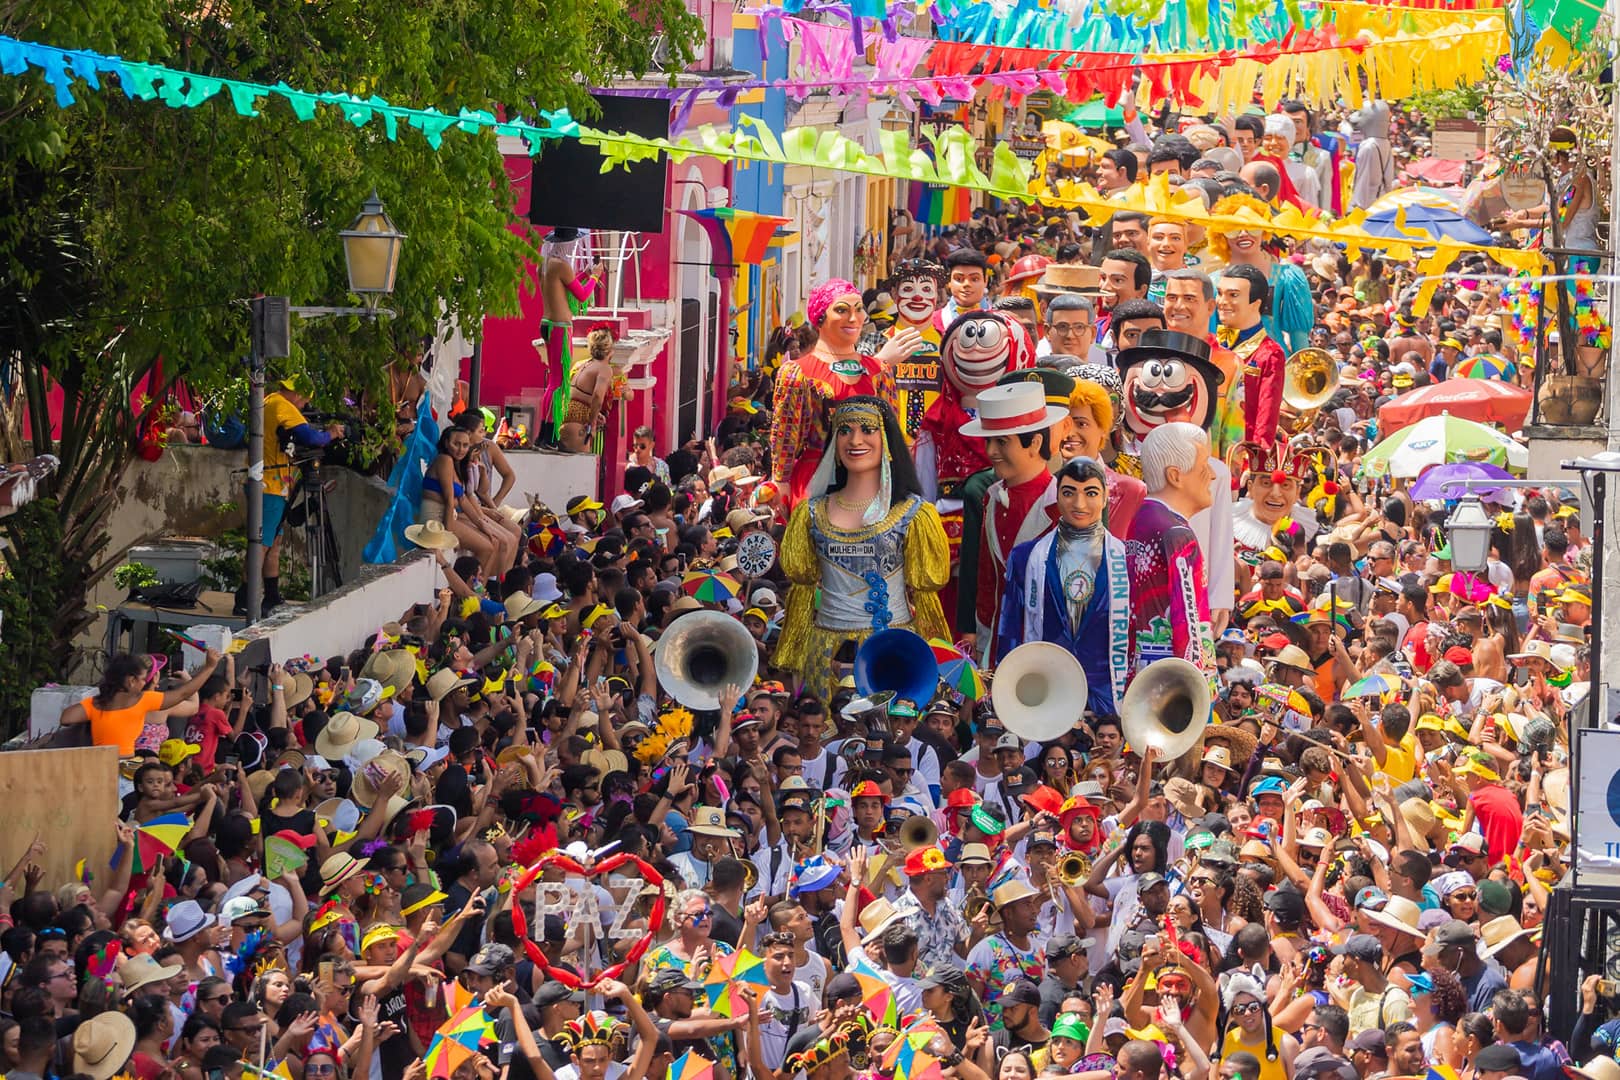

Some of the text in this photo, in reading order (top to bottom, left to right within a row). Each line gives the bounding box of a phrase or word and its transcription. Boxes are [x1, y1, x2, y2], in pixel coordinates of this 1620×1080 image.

[896, 360, 940, 379] PITÚ
[740, 553, 772, 573] ODARA
[829, 545, 857, 554] MULHER
[1109, 549, 1129, 600] JOHN
[1111, 604, 1129, 701] TRAVOLTA
[534, 878, 645, 942] PAZ
